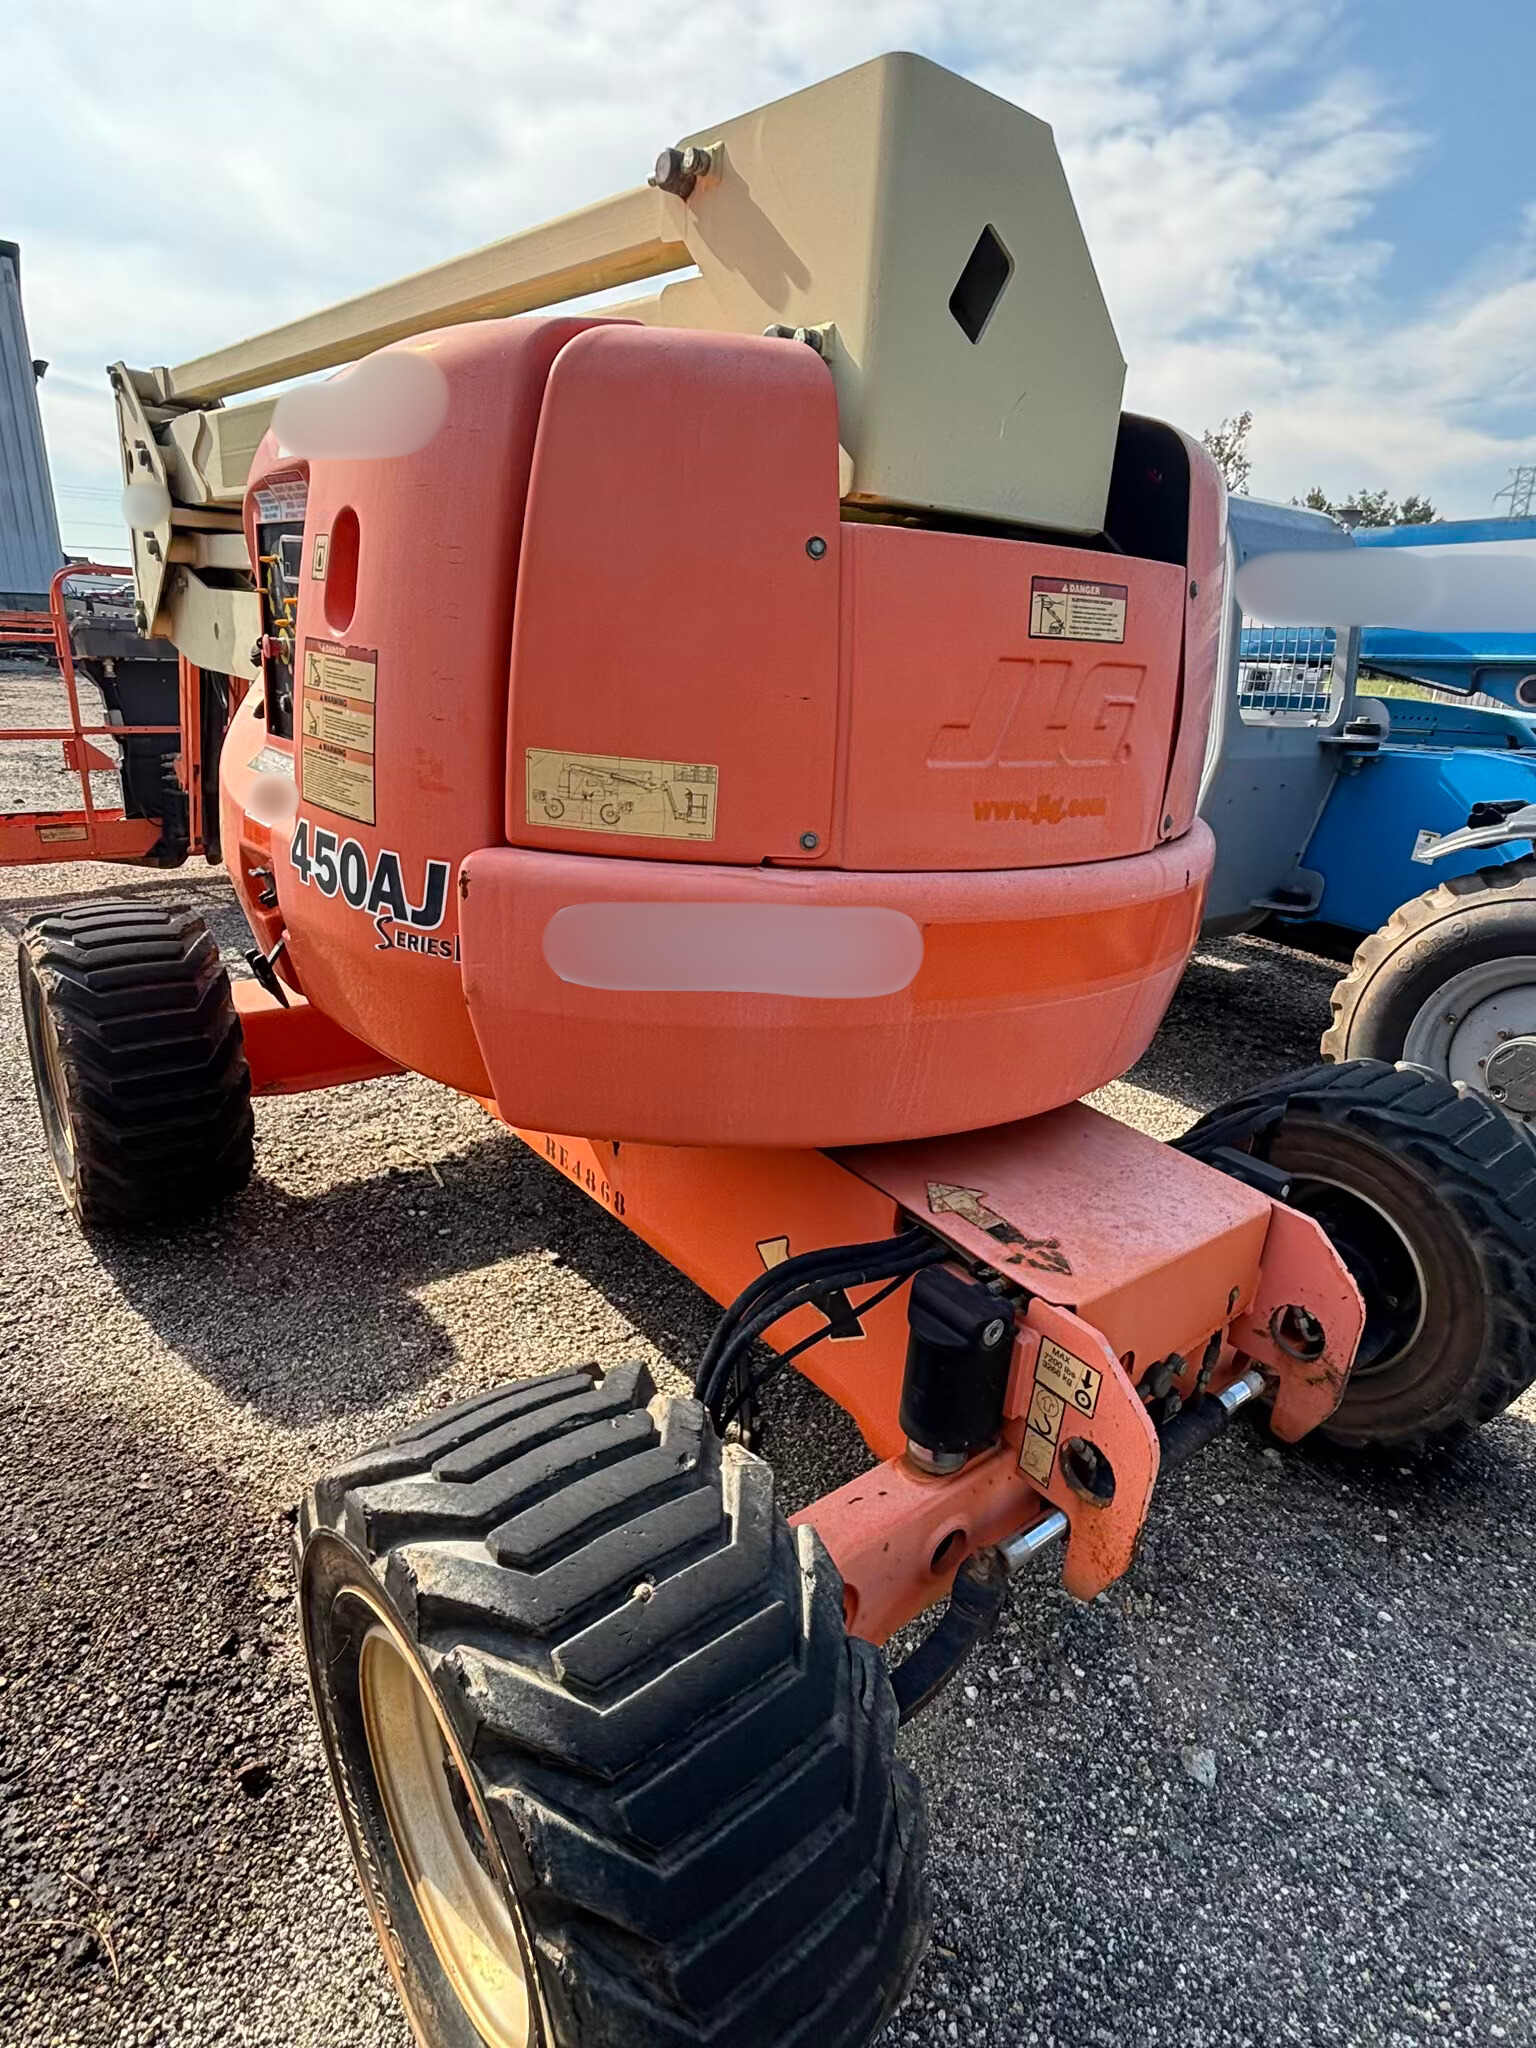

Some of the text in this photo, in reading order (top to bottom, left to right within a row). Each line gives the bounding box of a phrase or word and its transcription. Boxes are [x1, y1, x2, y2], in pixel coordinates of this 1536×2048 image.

[1070, 584, 1100, 595] DANGER
[290, 817, 451, 931] 450AJ
[545, 1134, 626, 1216] BE4868
[1043, 1352, 1077, 1379] 7200 lbs
[1052, 1347, 1071, 1364] MAX
[1062, 1373, 1073, 1387] kg
